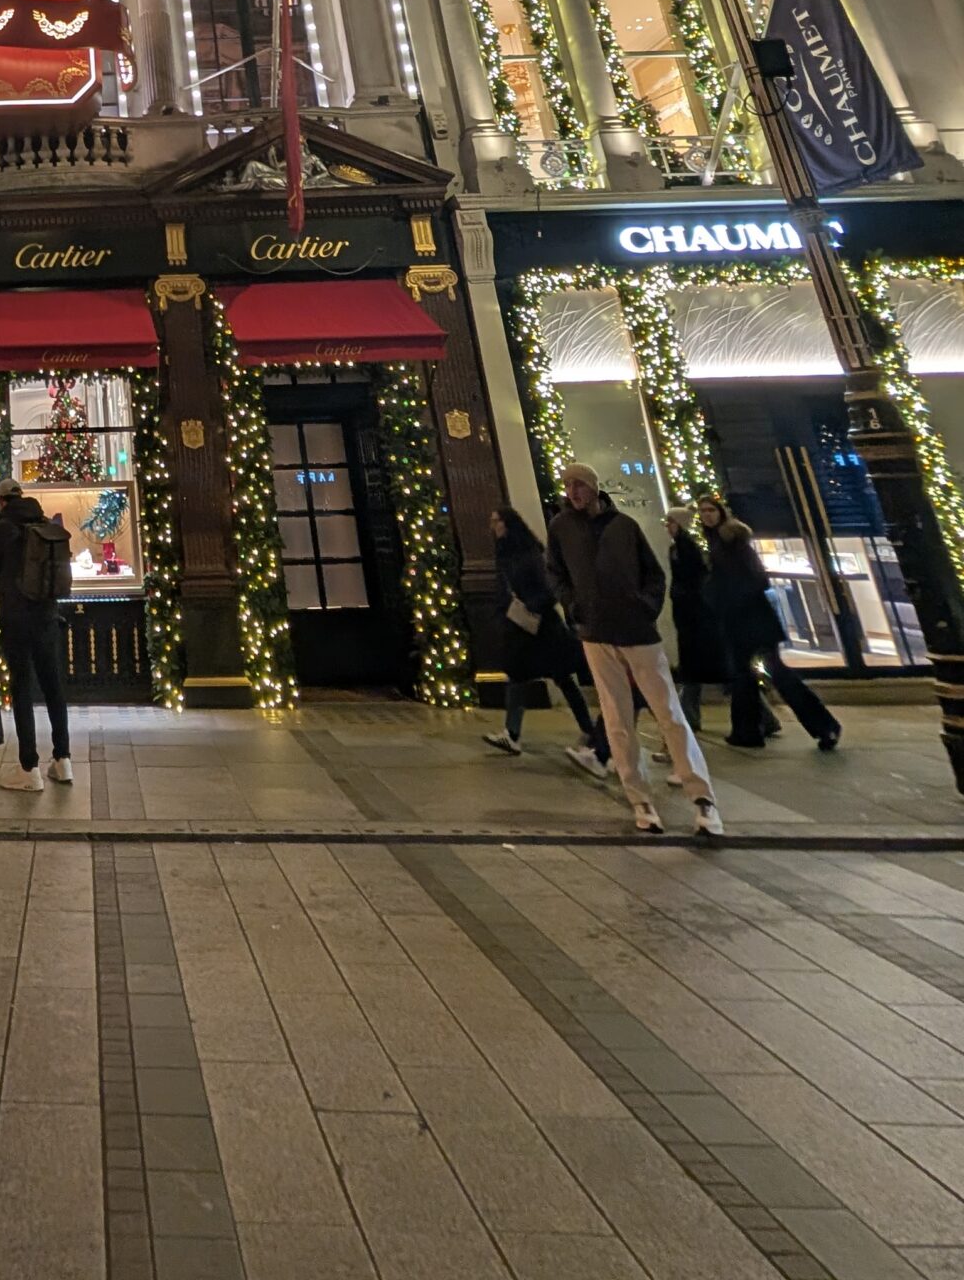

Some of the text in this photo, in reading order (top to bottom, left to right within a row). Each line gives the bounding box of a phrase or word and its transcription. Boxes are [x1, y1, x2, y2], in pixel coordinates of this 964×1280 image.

[791, 7, 877, 166] CHAUMET
[837, 58, 859, 99] PARIS
[250, 233, 351, 262] Cartier
[618, 221, 844, 254] CHAUM
[14, 242, 113, 270] Cartier
[41, 350, 91, 365] Cartier
[315, 342, 367, 358] Cartier
